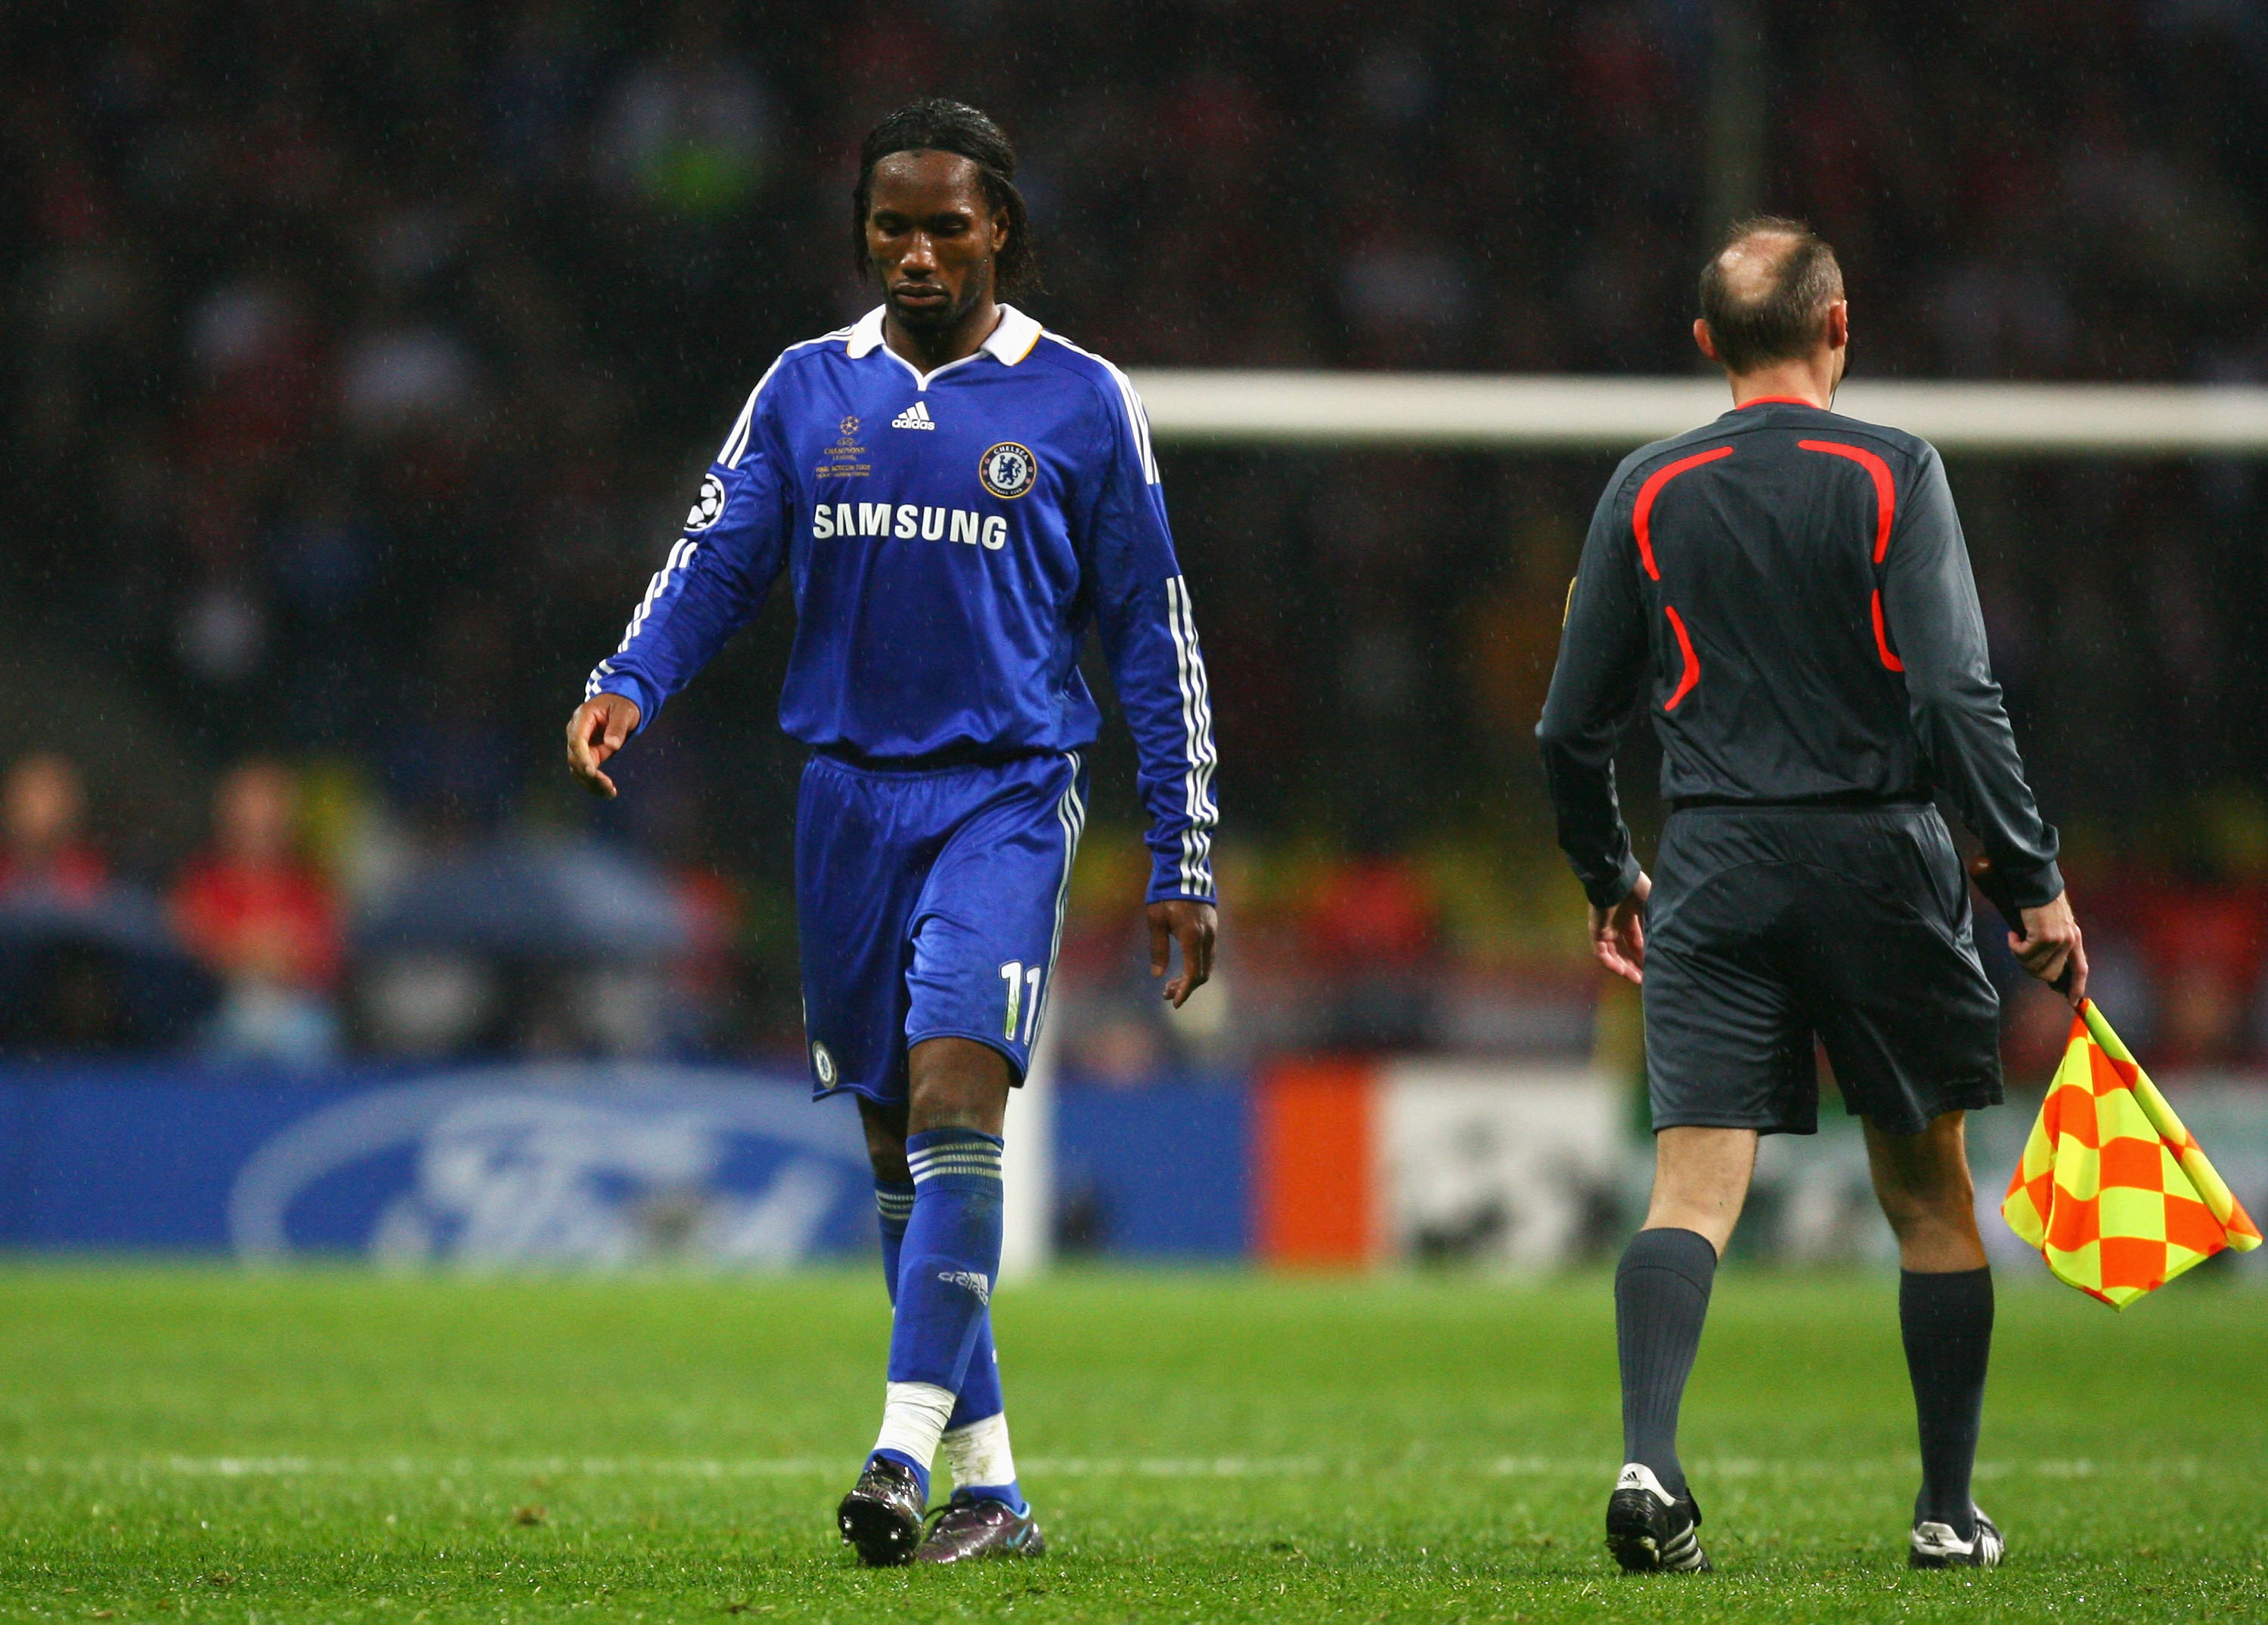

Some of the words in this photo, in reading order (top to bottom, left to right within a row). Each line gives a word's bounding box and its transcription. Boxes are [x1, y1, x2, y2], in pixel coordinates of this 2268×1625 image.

[891, 418, 935, 431] adidas
[993, 445, 1029, 460] CHELSEA
[813, 503, 1007, 550] SAMSUNG
[1000, 960, 1041, 1047] 11
